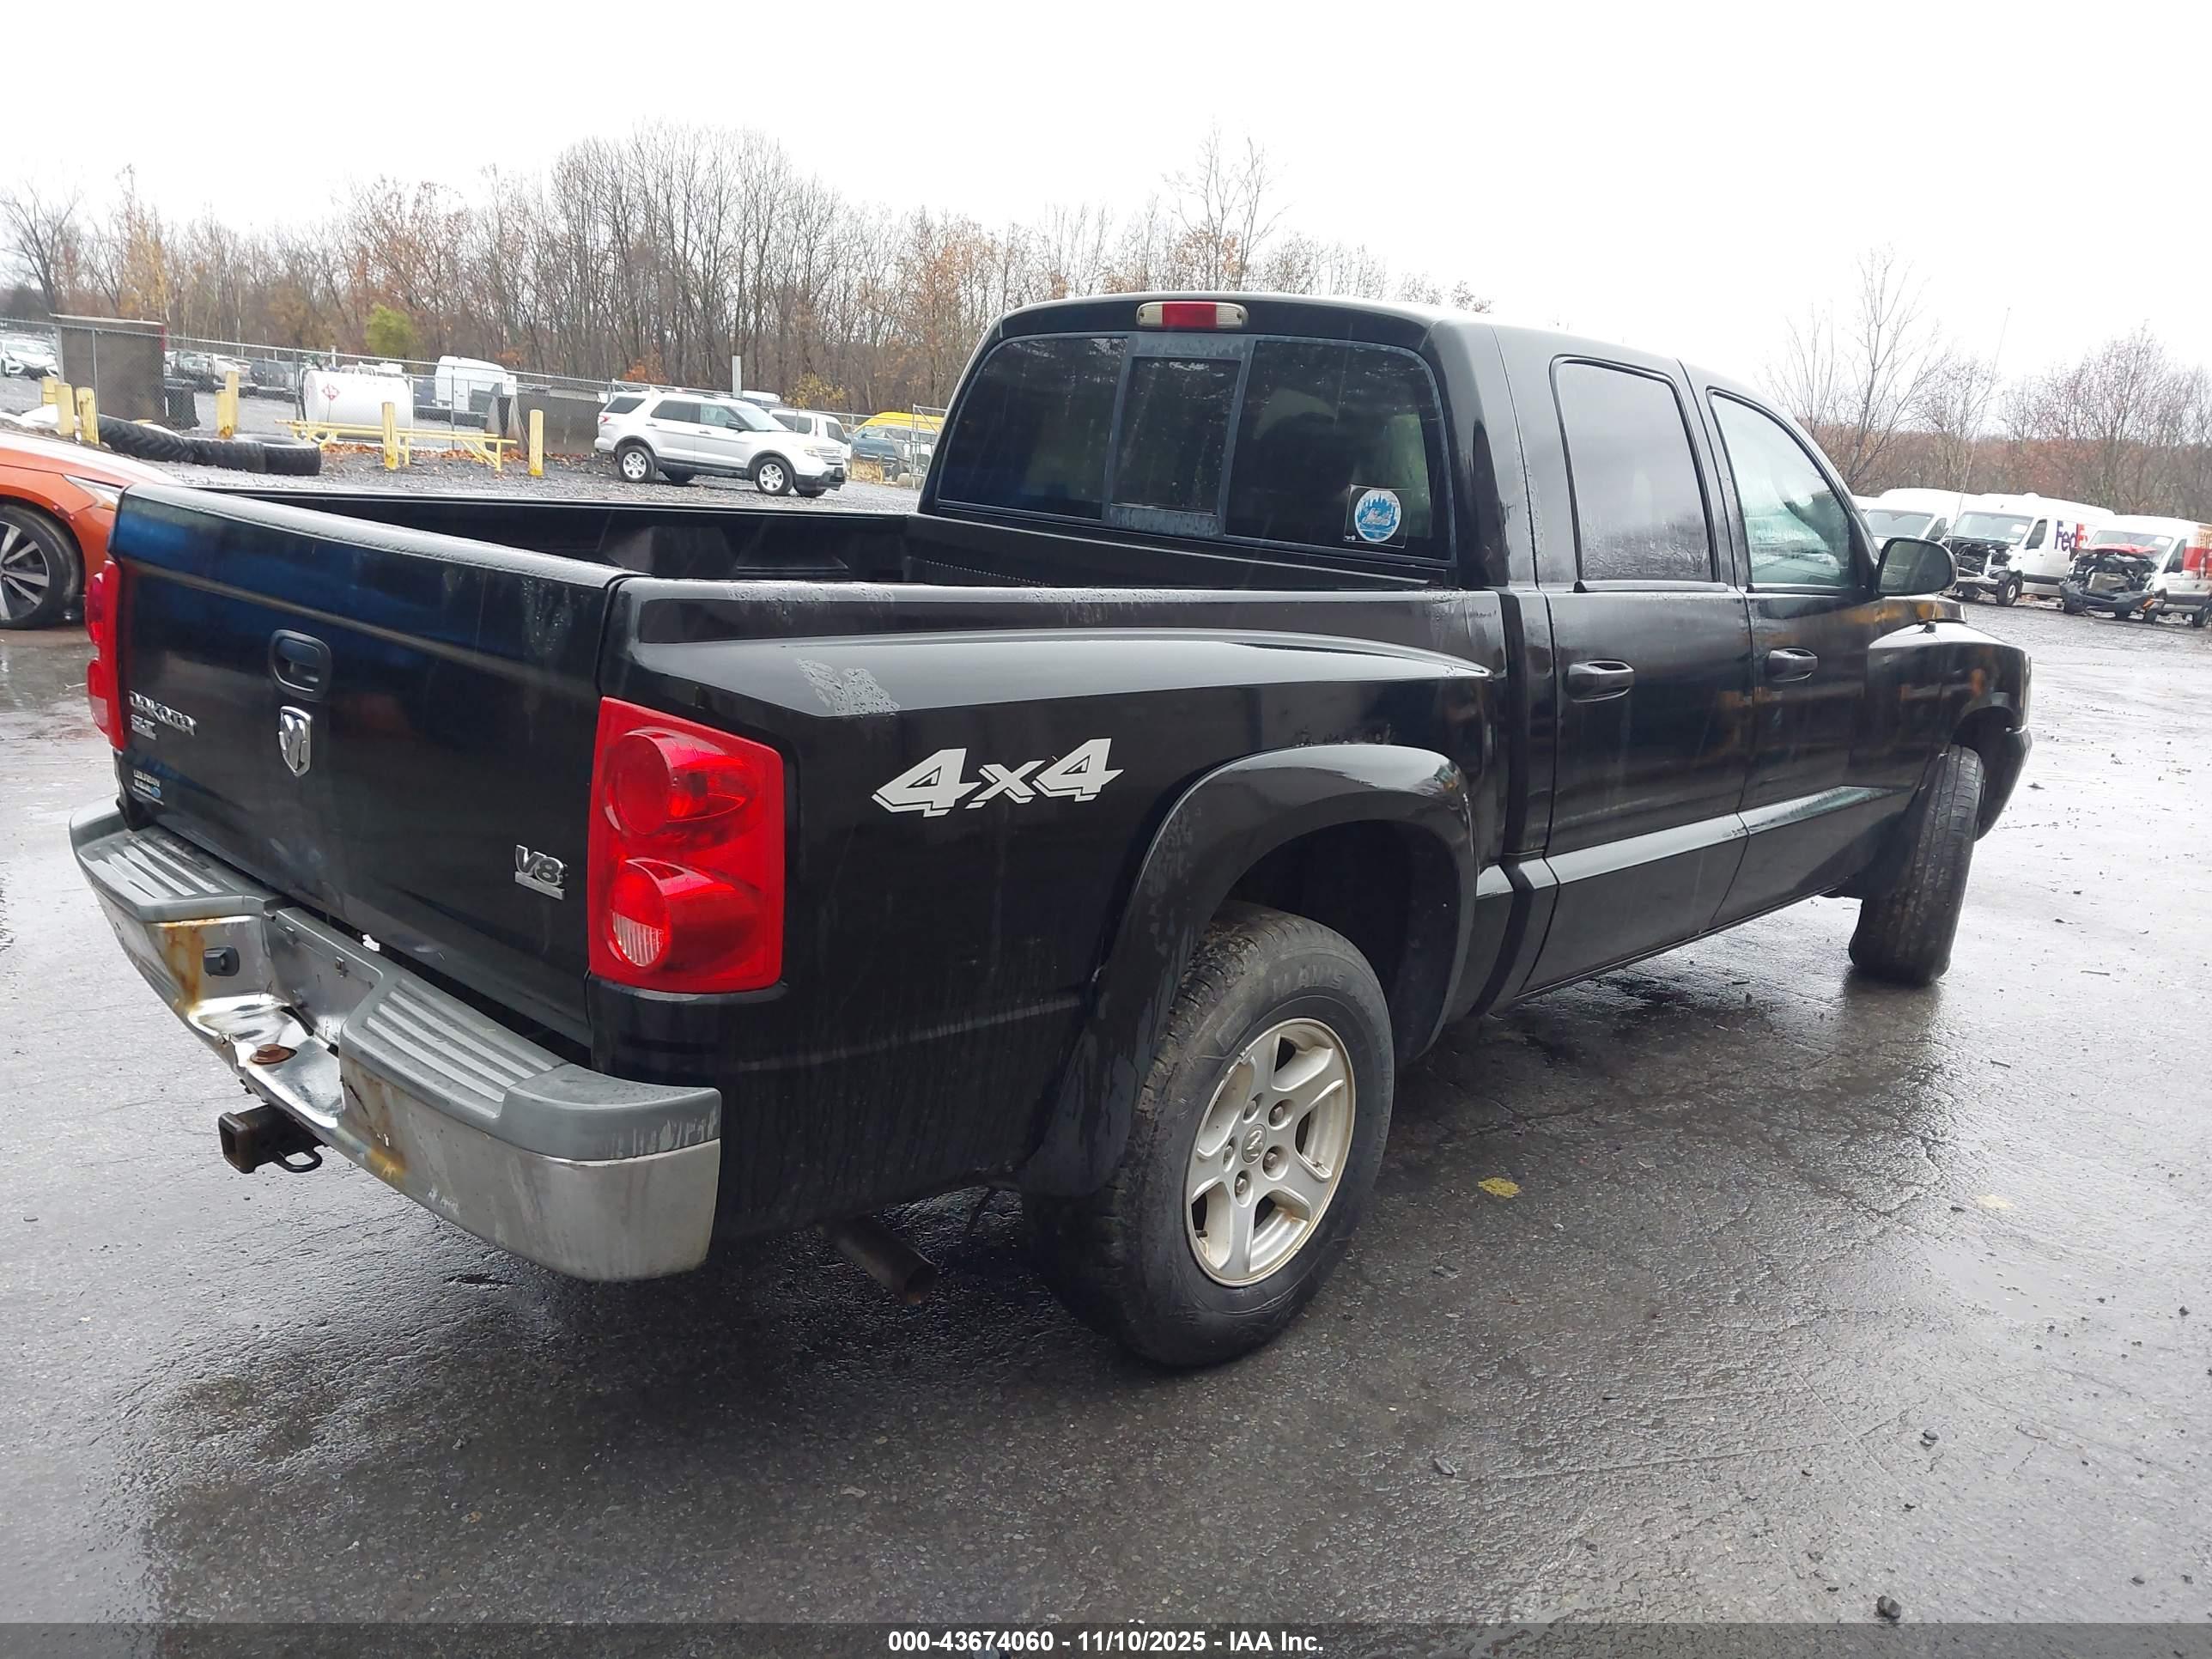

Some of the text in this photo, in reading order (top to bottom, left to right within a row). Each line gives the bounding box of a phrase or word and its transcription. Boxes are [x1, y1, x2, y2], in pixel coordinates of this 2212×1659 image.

[129, 690, 197, 736] DAKOTA
[871, 738, 1125, 817] 4x4
[515, 844, 564, 886] V8
